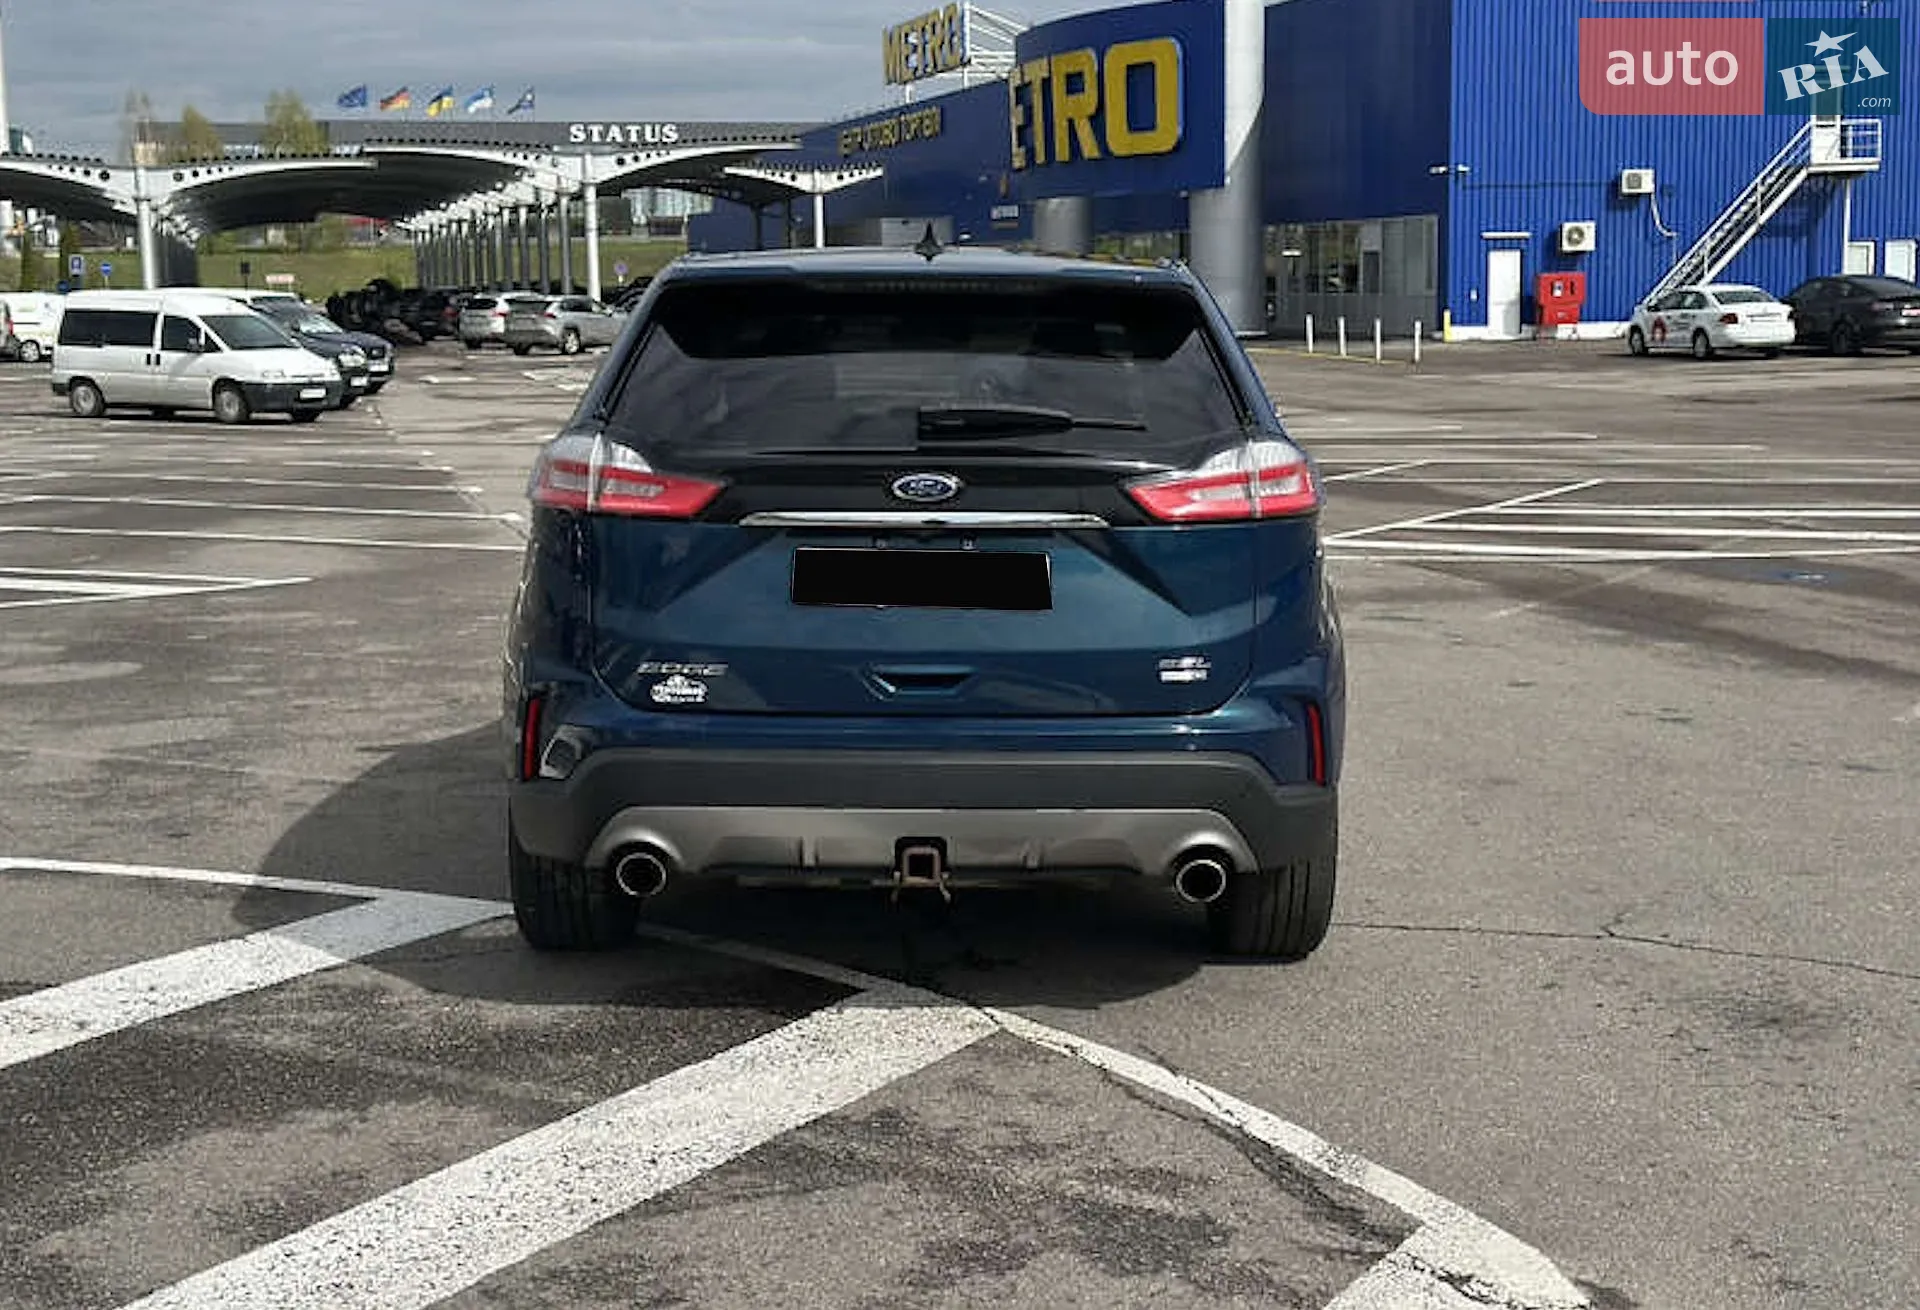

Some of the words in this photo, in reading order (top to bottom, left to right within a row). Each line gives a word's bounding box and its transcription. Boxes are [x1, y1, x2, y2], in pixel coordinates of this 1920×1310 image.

[882, 3, 963, 85] METRO
[569, 123, 679, 143] STATUS
[1009, 36, 1183, 170] ETRO
